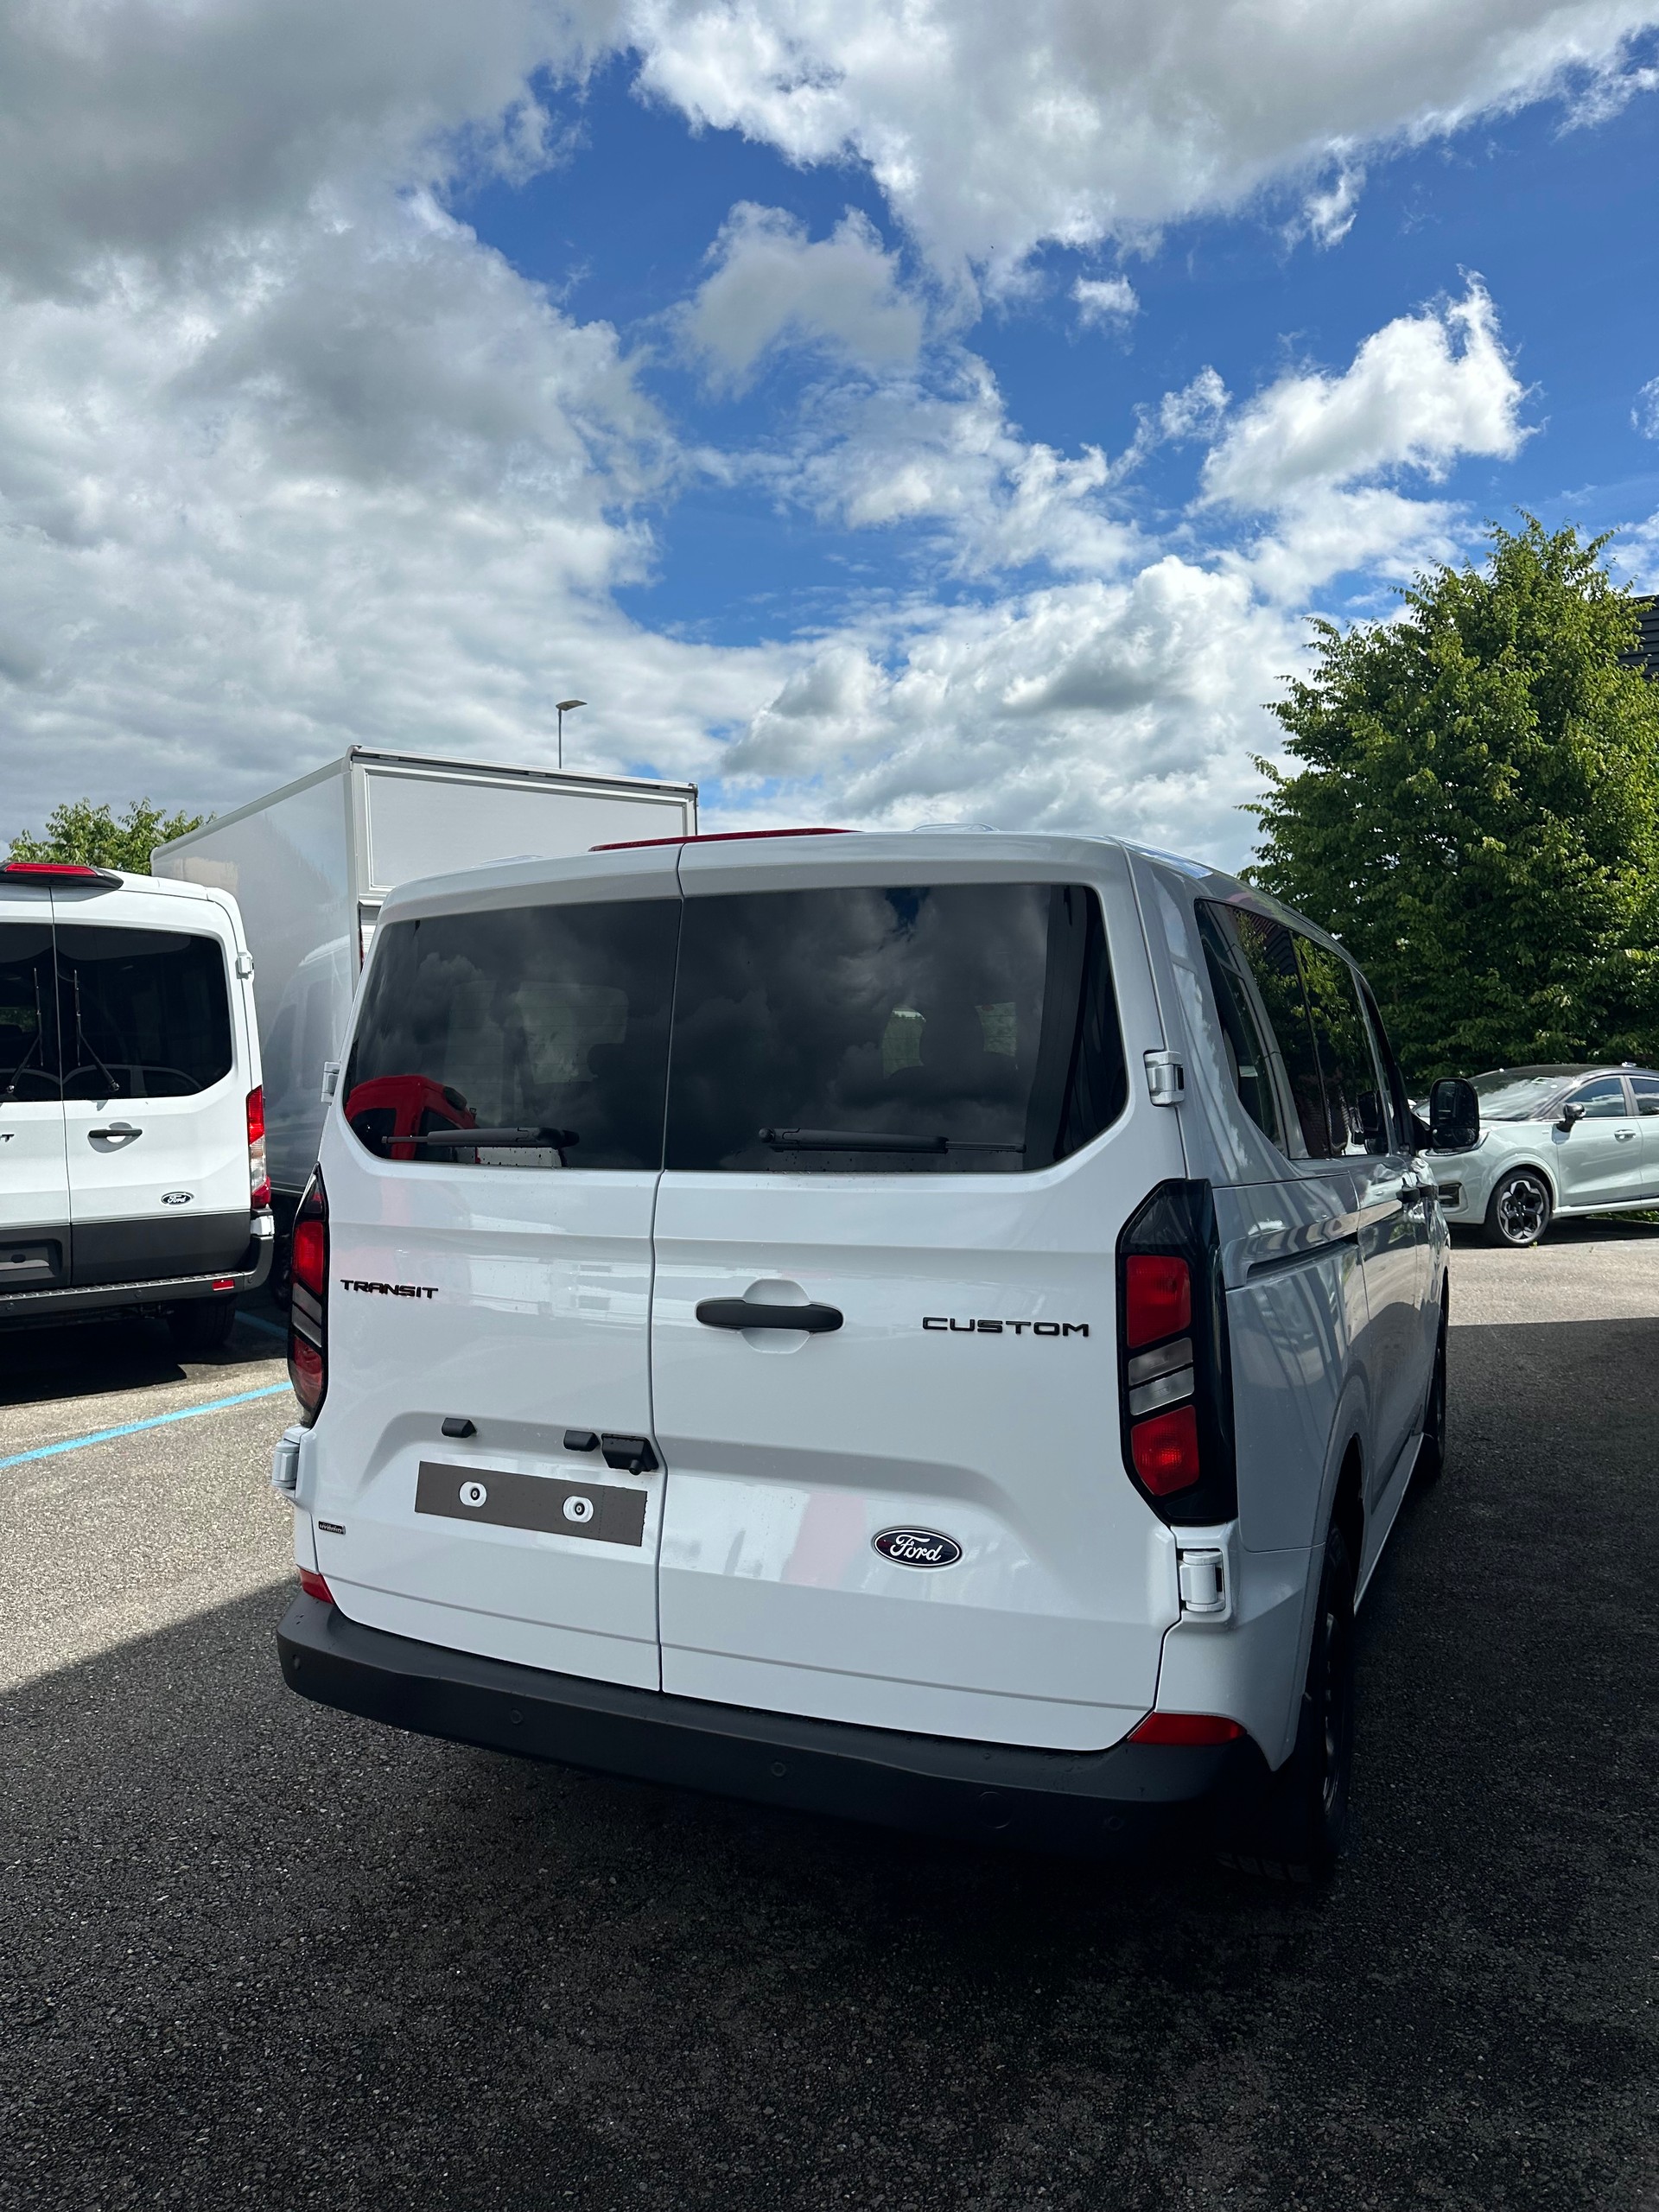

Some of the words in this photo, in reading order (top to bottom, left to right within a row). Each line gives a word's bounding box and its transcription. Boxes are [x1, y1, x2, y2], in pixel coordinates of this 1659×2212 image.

[0, 1134, 15, 1142] T
[340, 1279, 439, 1299] TRANSIT
[922, 1316, 1090, 1337] CUSTOM
[889, 1534, 944, 1561] Ford
